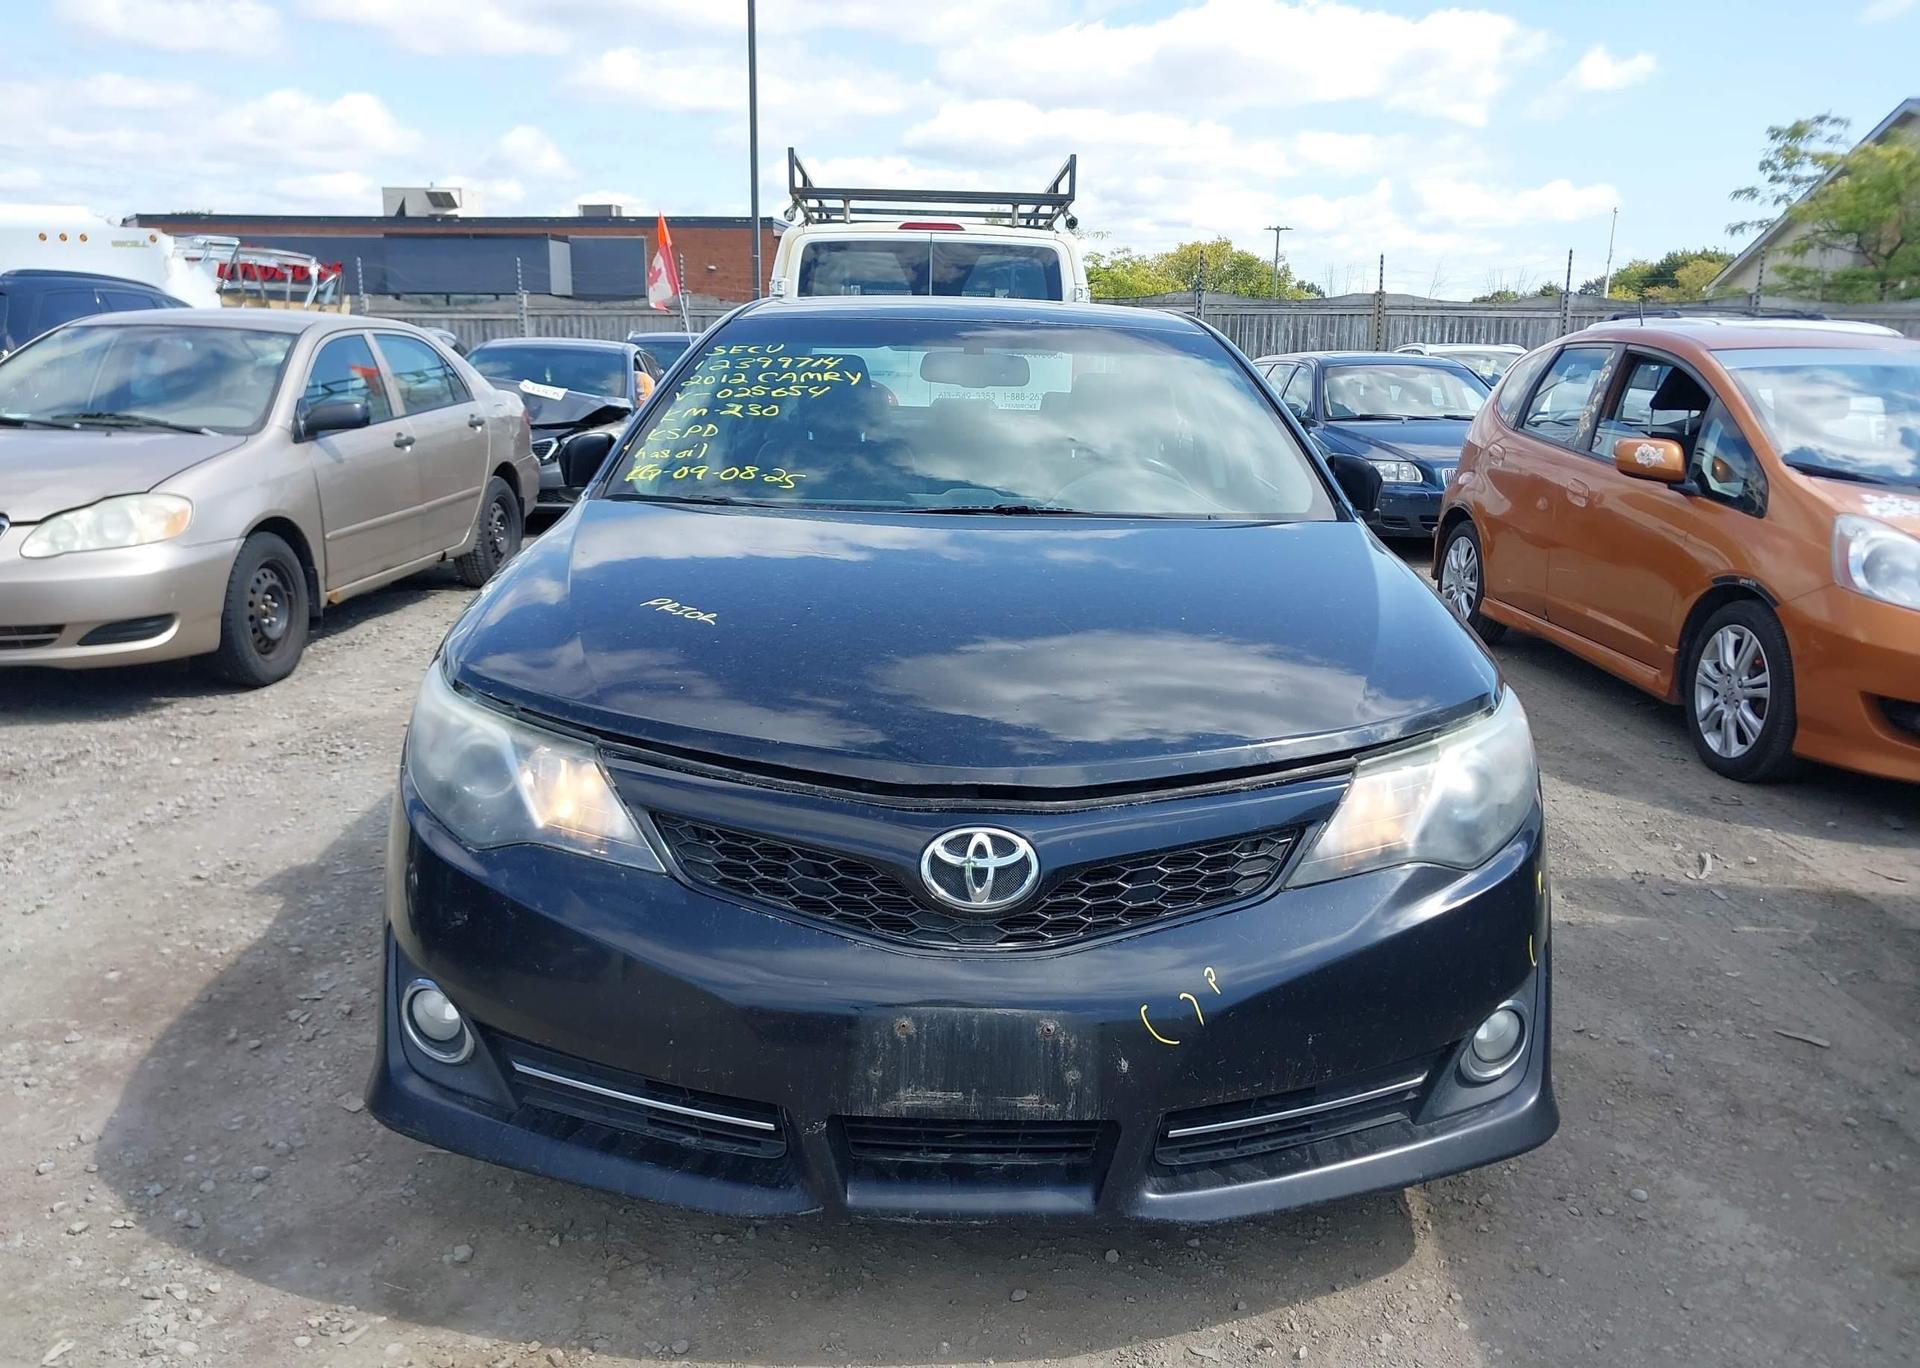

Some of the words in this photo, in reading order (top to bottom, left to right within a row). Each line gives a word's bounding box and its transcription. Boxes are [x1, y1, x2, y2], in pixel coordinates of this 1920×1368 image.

[705, 343, 785, 356] SECU
[694, 356, 843, 371] 12399714
[681, 373, 748, 387] 2012
[757, 370, 862, 386] CAMRY
[675, 442, 708, 459] oil
[639, 598, 718, 626] PRIOR
